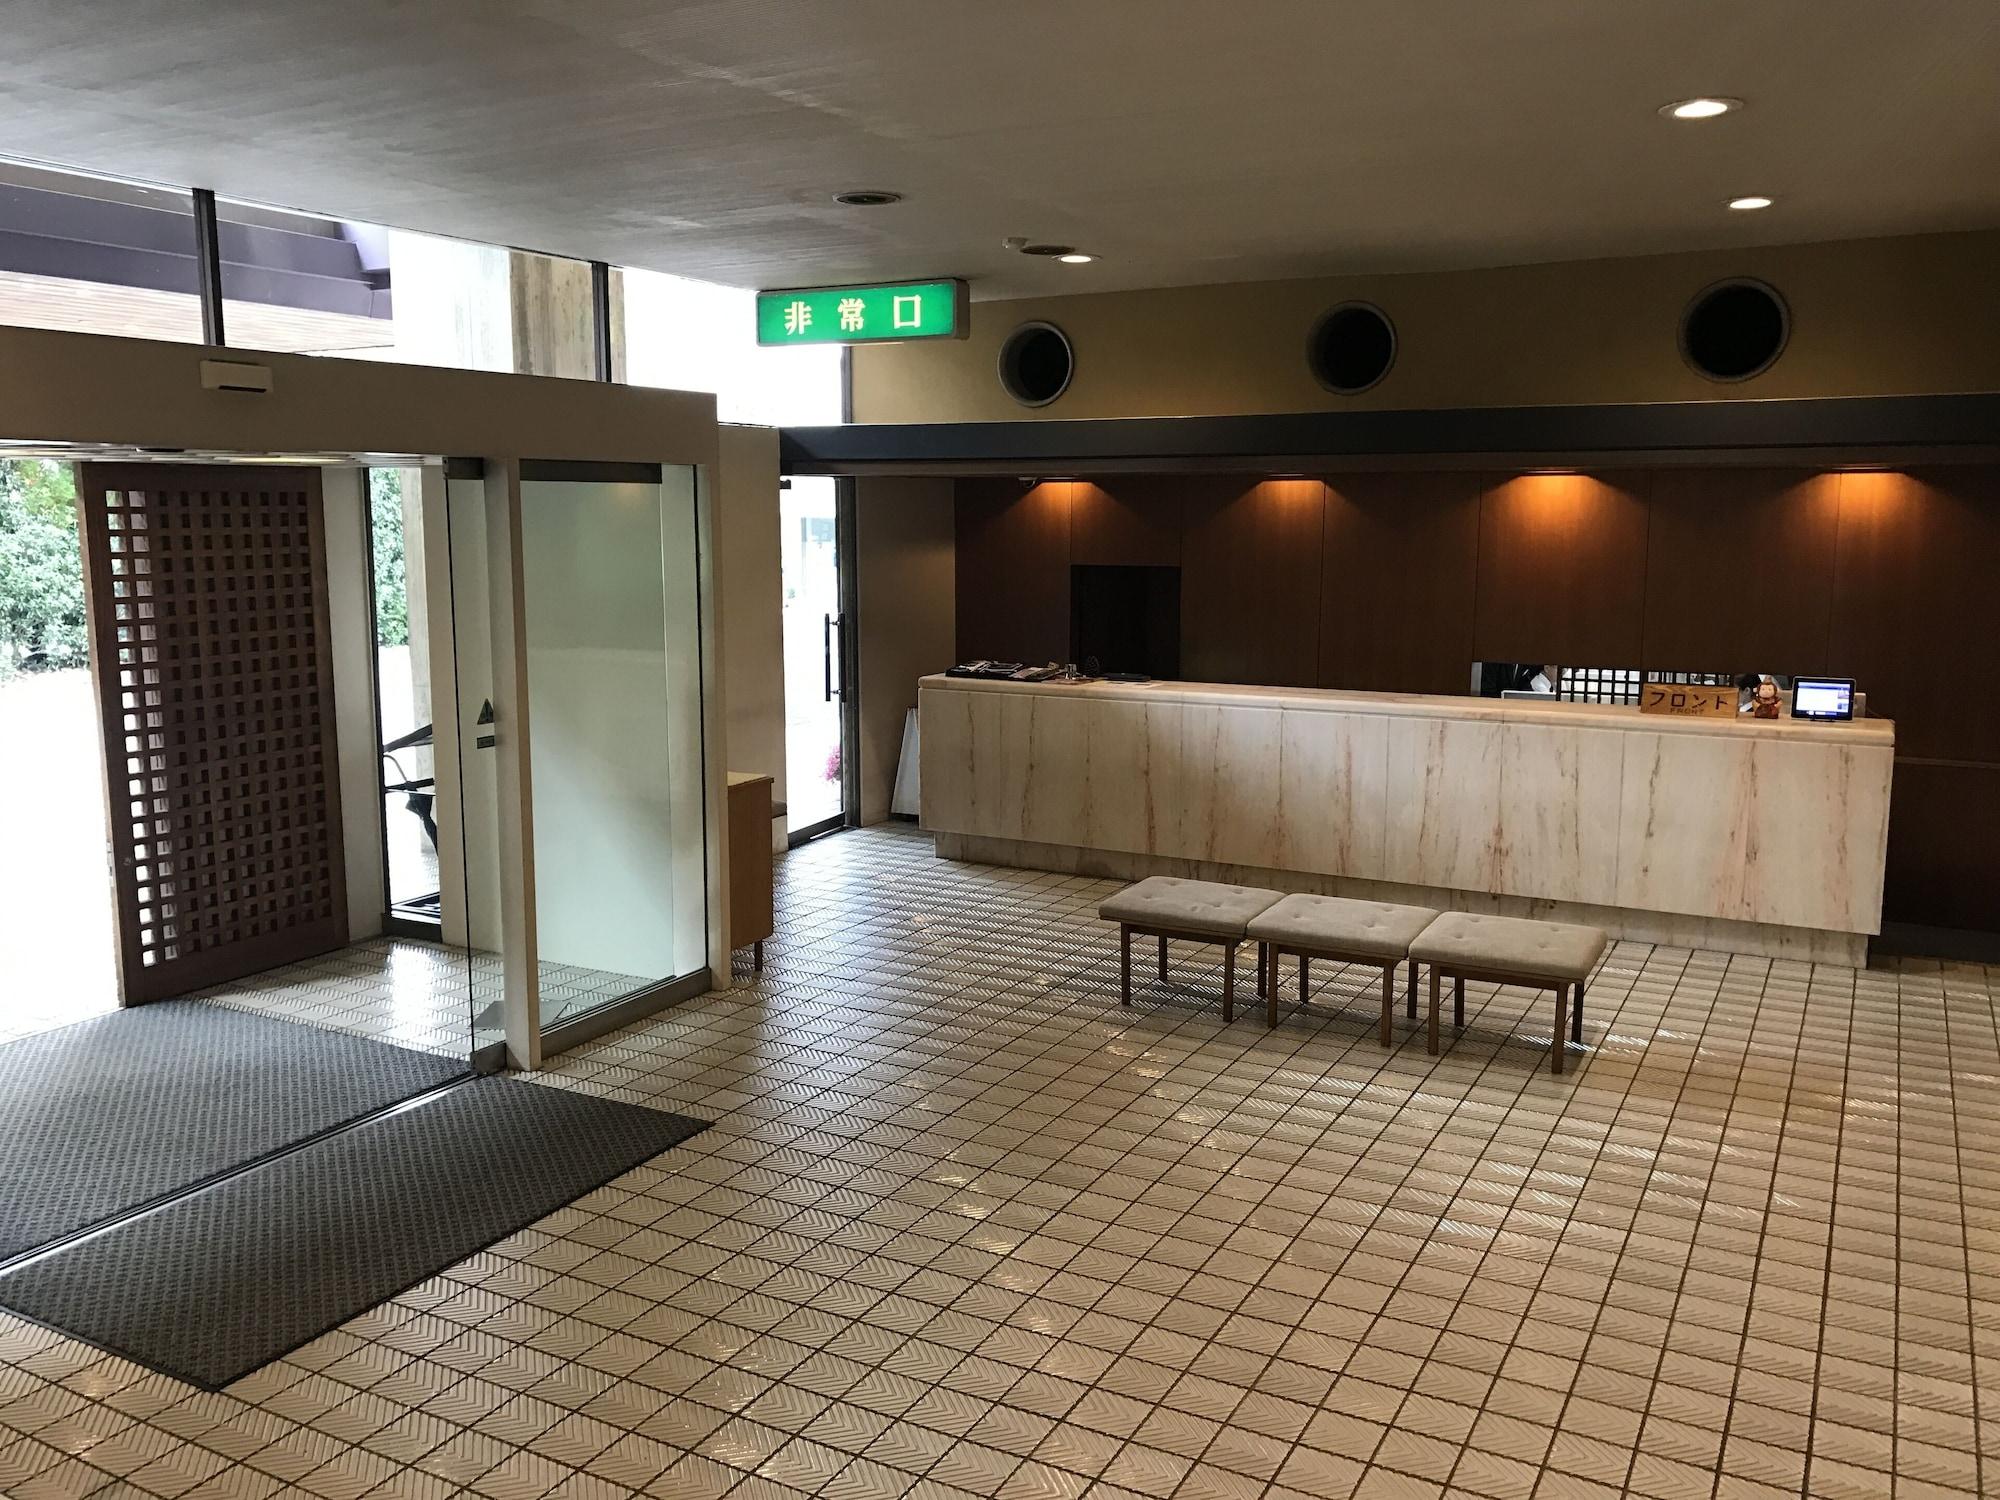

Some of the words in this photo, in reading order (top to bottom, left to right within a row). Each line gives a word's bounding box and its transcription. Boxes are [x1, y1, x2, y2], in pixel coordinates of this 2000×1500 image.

[784, 295, 921, 335] 非常口
[1650, 692, 1728, 710] フロント
[1670, 707, 1704, 715] FRONT
